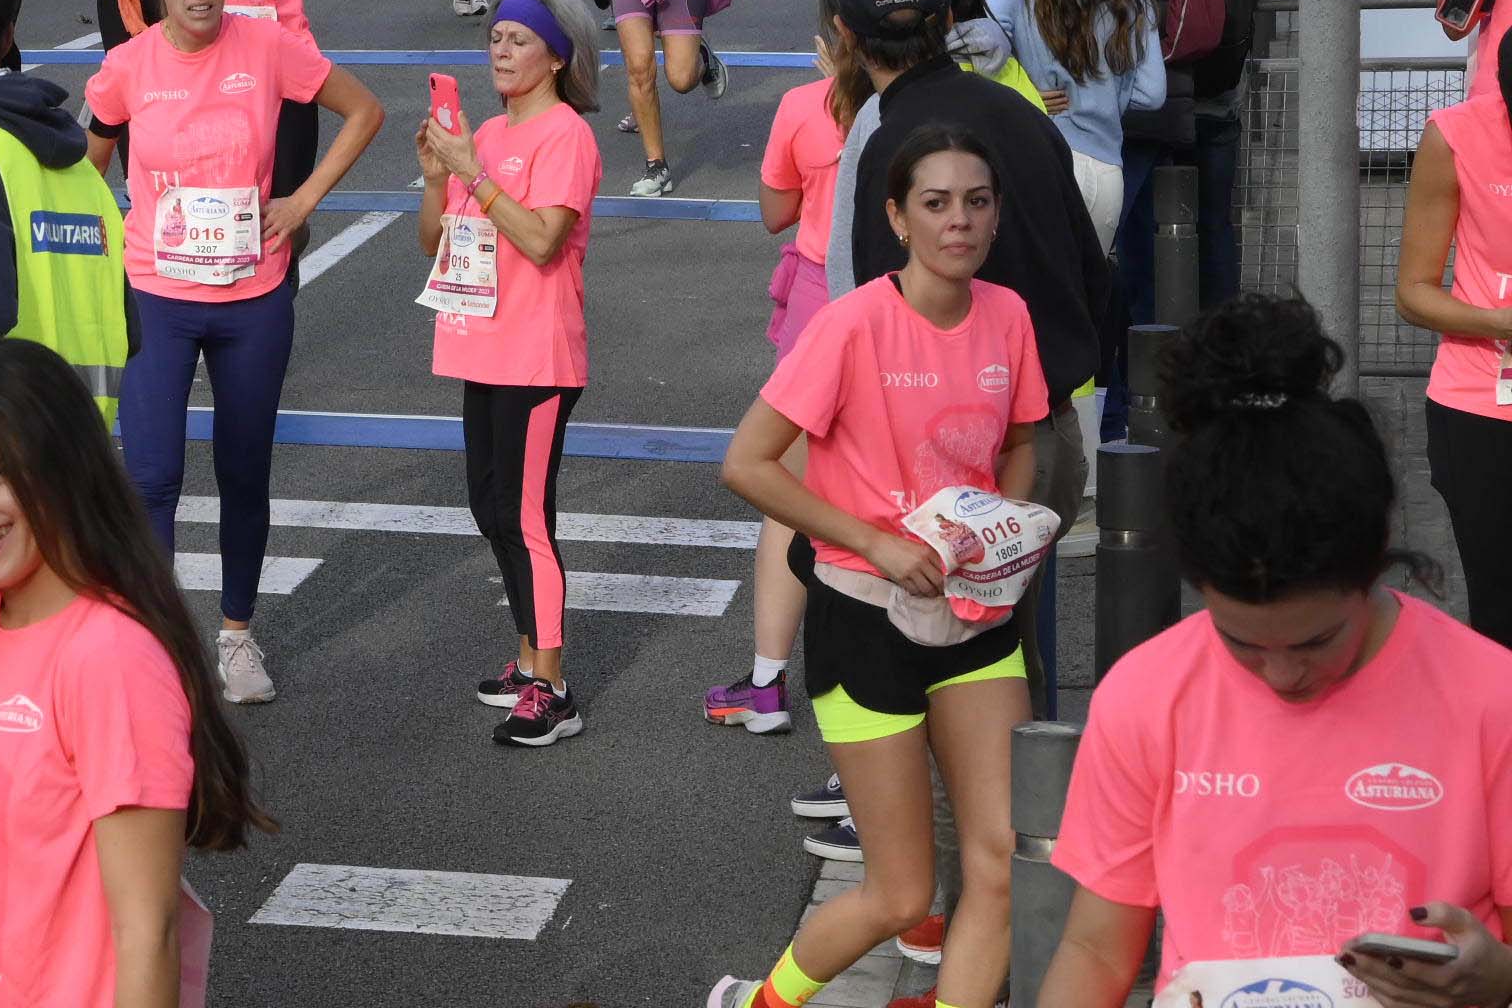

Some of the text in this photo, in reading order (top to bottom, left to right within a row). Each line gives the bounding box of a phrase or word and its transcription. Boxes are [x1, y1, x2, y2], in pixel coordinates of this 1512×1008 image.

[144, 89, 188, 103] OYSHO
[189, 227, 225, 241] 016
[195, 245, 218, 254] 3207
[166, 254, 194, 263] CARRERA
[451, 254, 470, 270] 016
[455, 273, 462, 282] 25
[981, 516, 1021, 545] 016
[995, 541, 1024, 562] 18097
[962, 566, 1002, 582] CARRERA
[1002, 565, 1012, 576] DE
[1012, 562, 1021, 572] LA
[958, 581, 1003, 598] OYSHO
[1351, 779, 1437, 800] ASTURIANA
